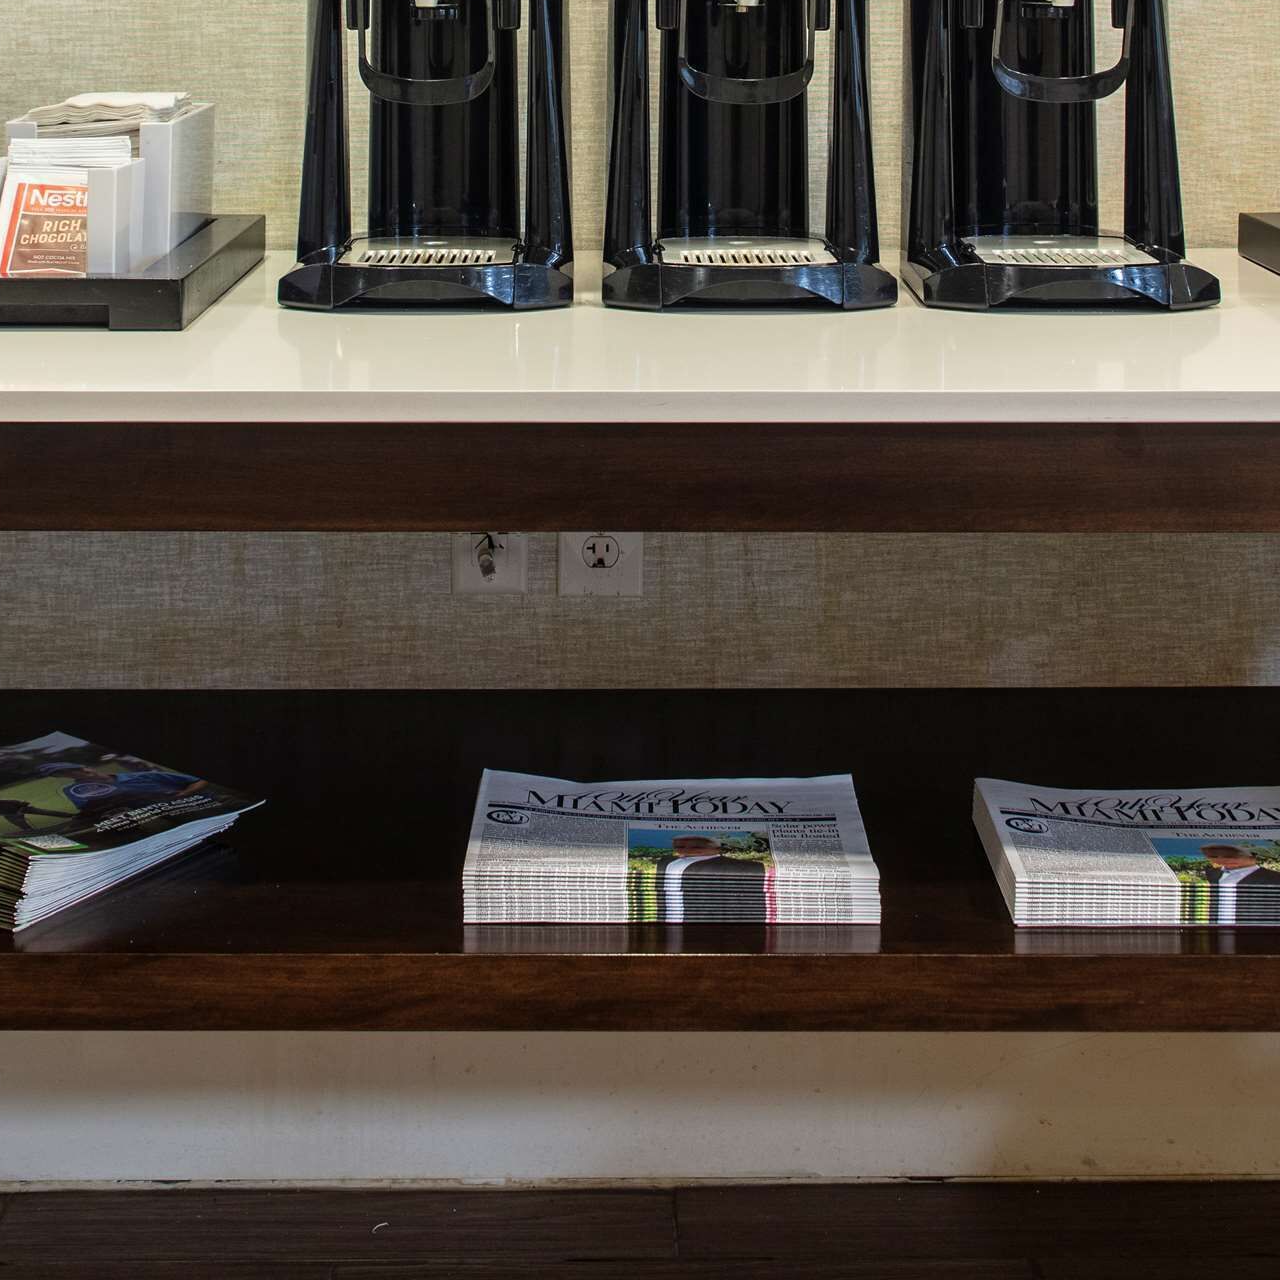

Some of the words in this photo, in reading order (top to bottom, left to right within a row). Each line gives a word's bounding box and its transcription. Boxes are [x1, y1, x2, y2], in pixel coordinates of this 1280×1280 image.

[42, 219, 81, 233] RICH
[527, 790, 655, 814] MIAMI
[656, 799, 793, 814] TODAY
[1029, 797, 1161, 822] MIAMI
